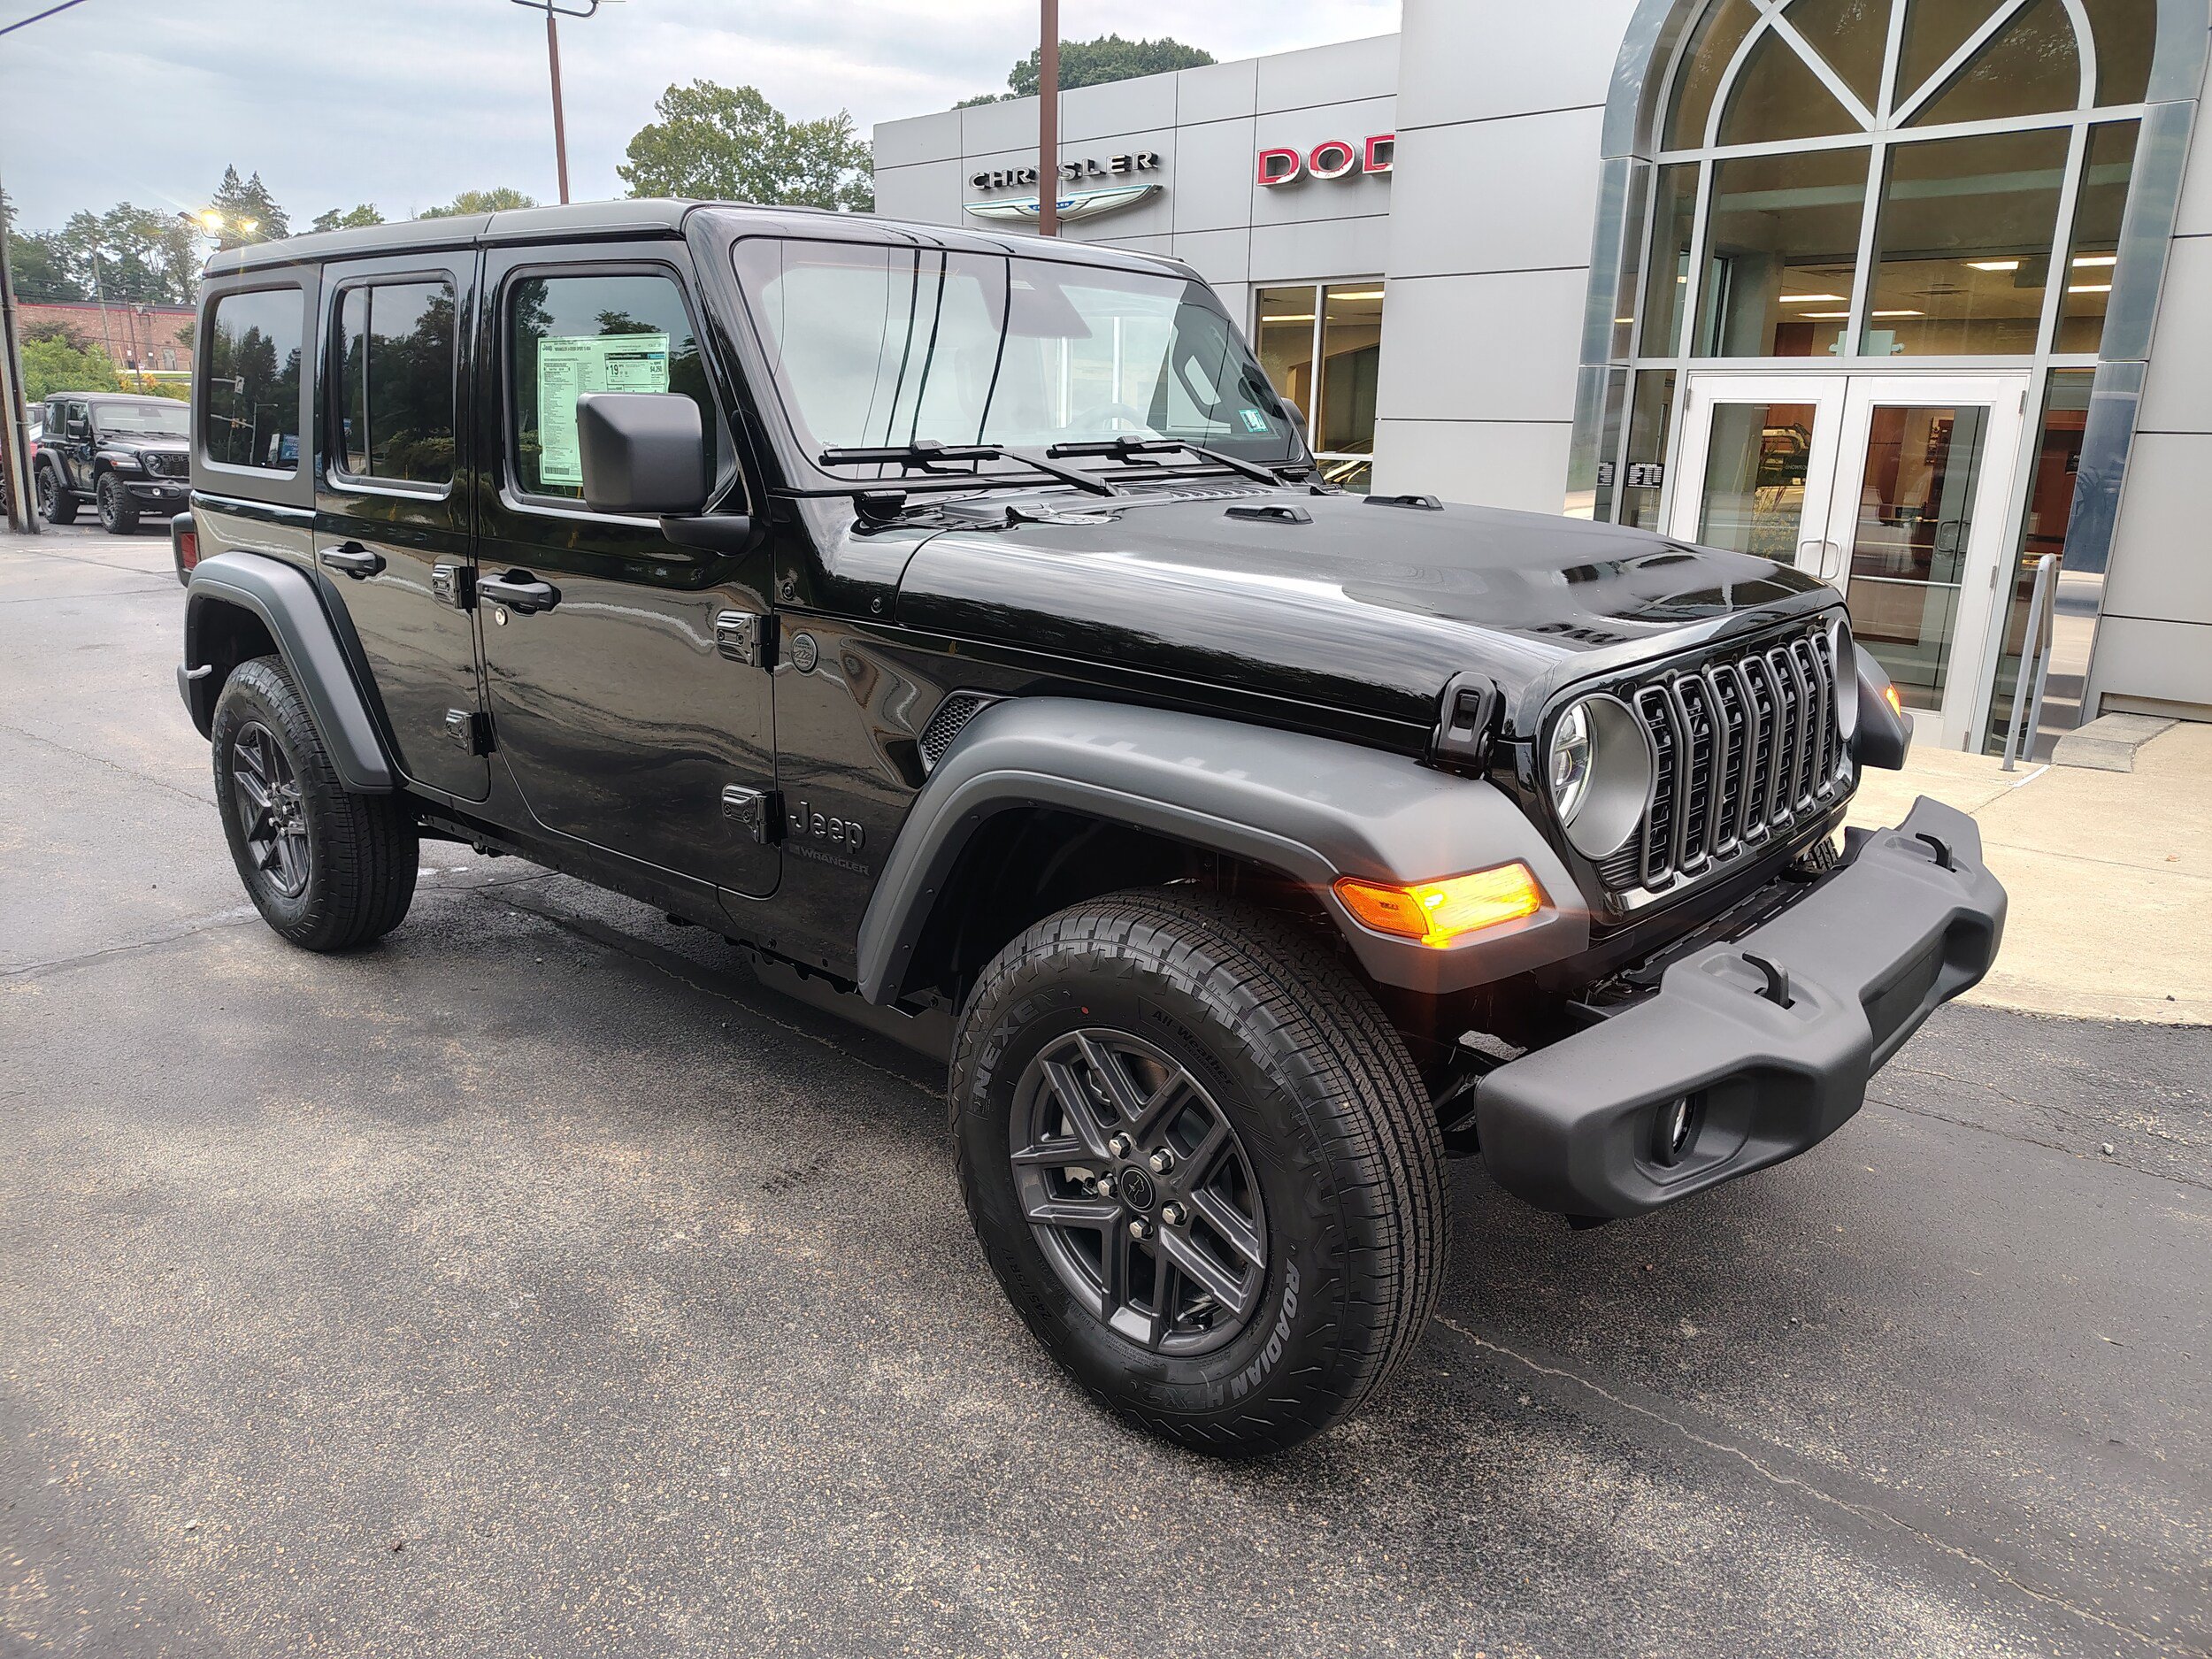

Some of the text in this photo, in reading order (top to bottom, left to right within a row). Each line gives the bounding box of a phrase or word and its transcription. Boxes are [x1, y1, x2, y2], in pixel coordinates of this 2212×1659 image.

[969, 150, 1158, 190] CHRSLER
[610, 365, 618, 375] 19
[789, 800, 866, 855] Jeep
[799, 845, 870, 877] WRANGLER
[1151, 1010, 1234, 1087] All-Weather
[1229, 1257, 1301, 1401] ROADIAN
